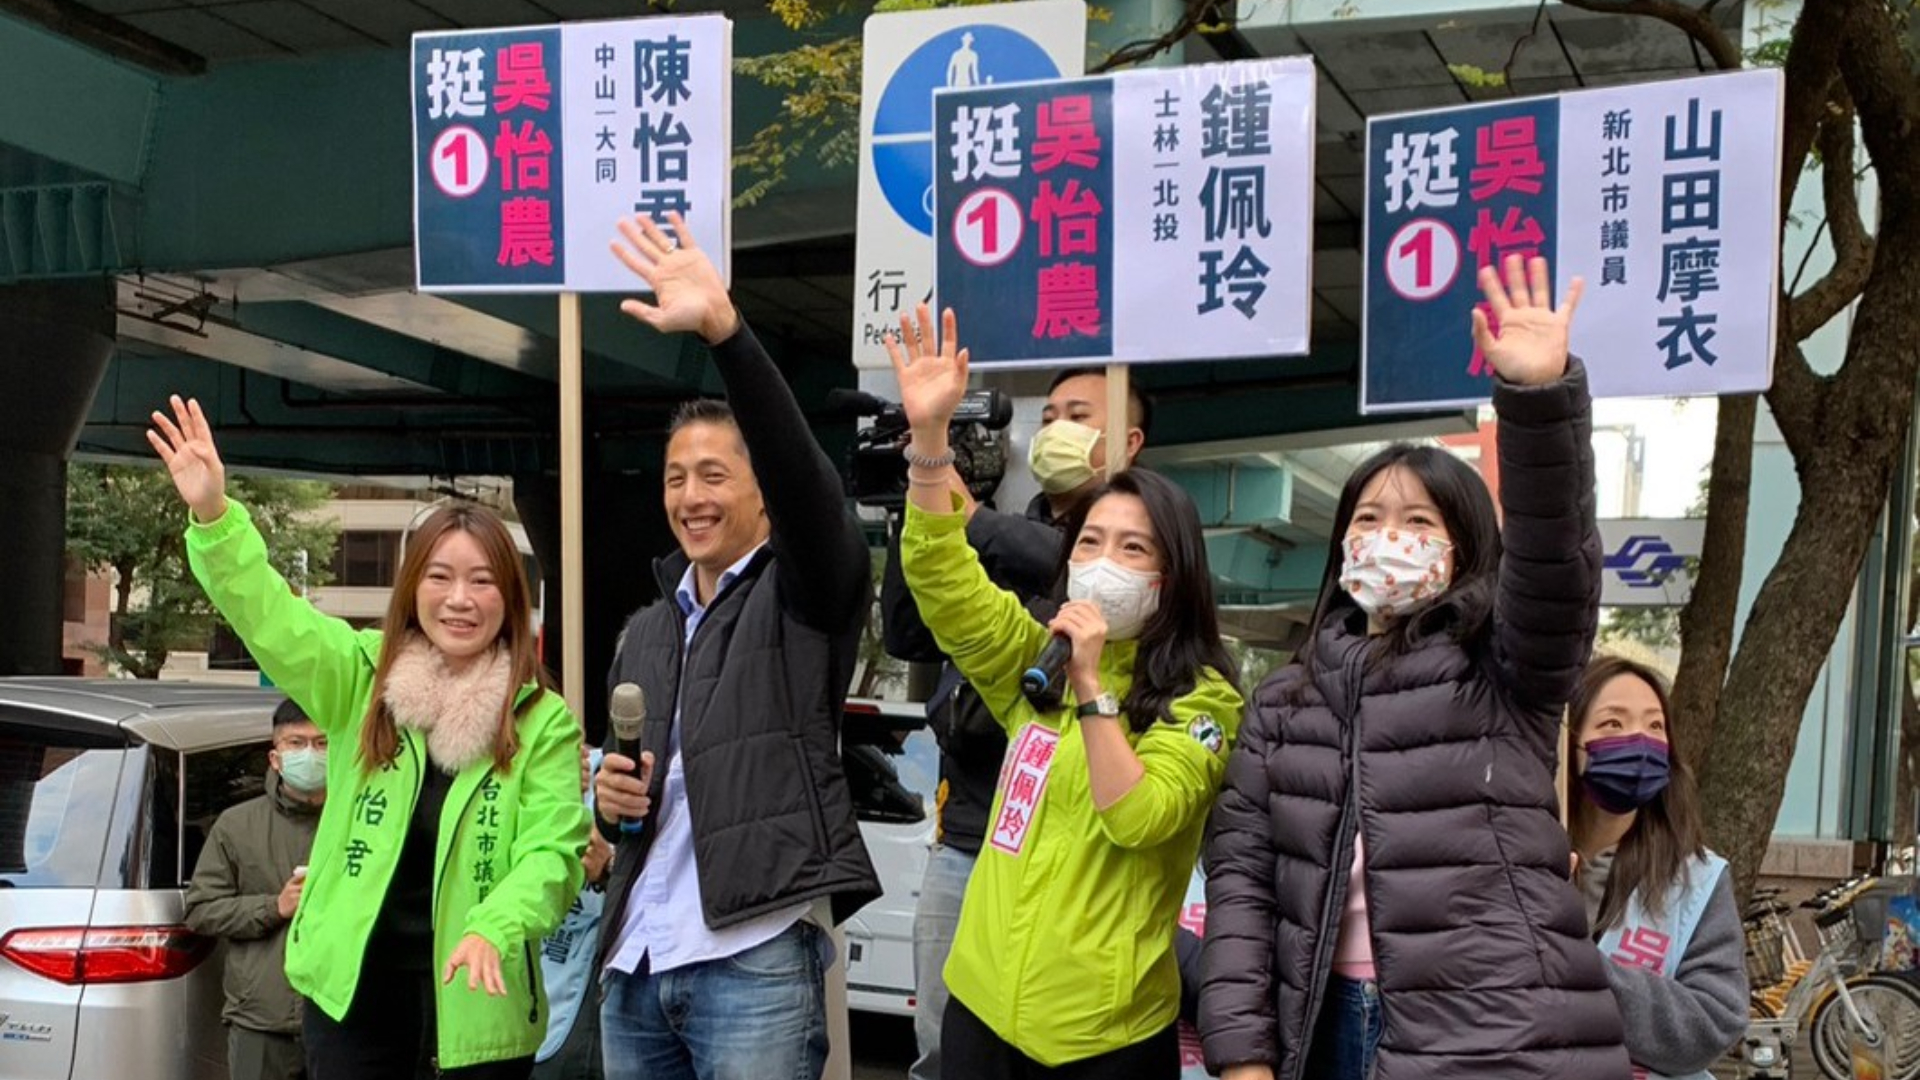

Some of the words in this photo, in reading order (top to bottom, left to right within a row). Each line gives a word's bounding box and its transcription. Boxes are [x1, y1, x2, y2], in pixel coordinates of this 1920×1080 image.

[427, 48, 487, 119] 挺
[950, 102, 1023, 183] 挺
[442, 134, 469, 186] 1
[493, 42, 554, 267] 吳怡農
[1031, 94, 1101, 339] 吳怡農
[1197, 80, 1272, 320] 鍾佩玲
[1384, 127, 1459, 214] 挺
[1600, 109, 1632, 286] 新北市議員
[967, 197, 999, 254] 1
[1399, 228, 1433, 288] 1
[1467, 115, 1545, 377] 吳怡
[1656, 98, 1722, 370] 山田摩衣
[345, 737, 405, 877] 怡君
